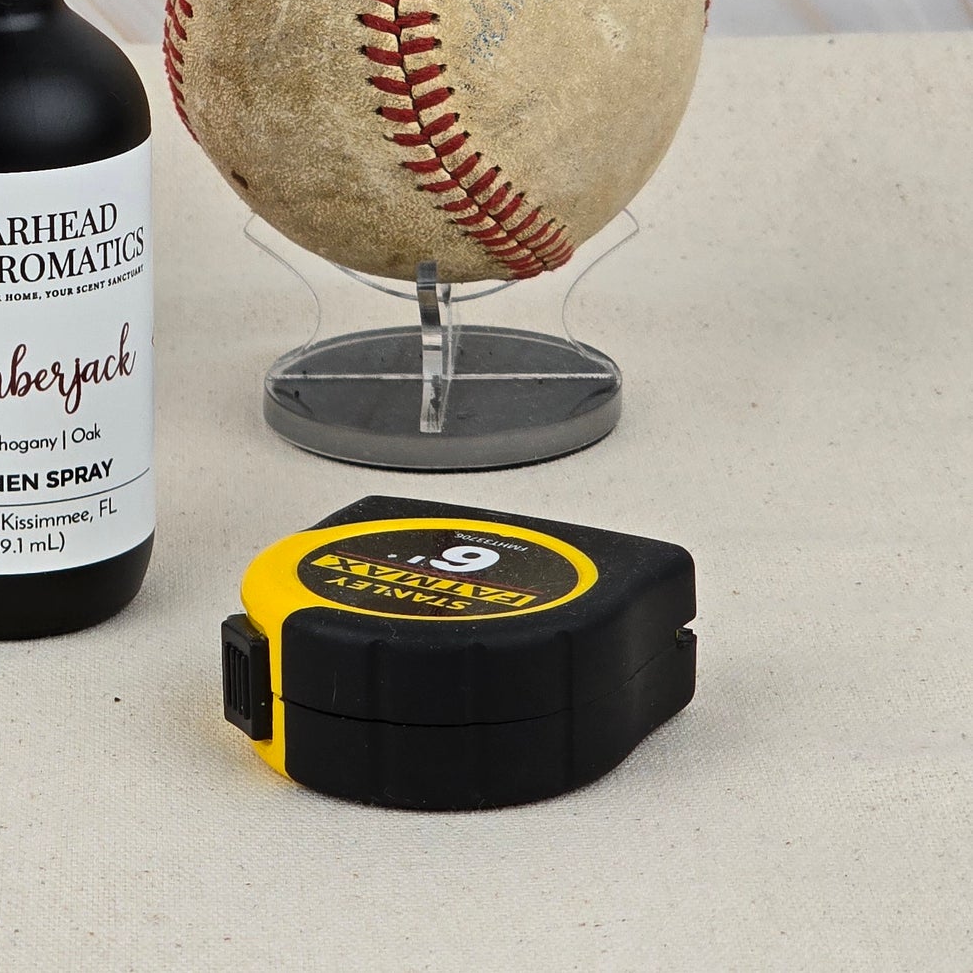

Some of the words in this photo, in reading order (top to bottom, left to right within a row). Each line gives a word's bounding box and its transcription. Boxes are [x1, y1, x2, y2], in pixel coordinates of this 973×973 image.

[5, 292, 42, 302] HOME,
[45, 288, 74, 299] YOUR
[76, 281, 105, 294] SCENT
[71, 423, 101, 444] Oak
[46, 458, 114, 488] SPRAY
[1, 510, 94, 531] Kissimmee,
[99, 497, 118, 517] FL
[30, 531, 66, 553] mL)
[327, 576, 467, 611] STANLEY
[328, 555, 525, 607] FATMAX
